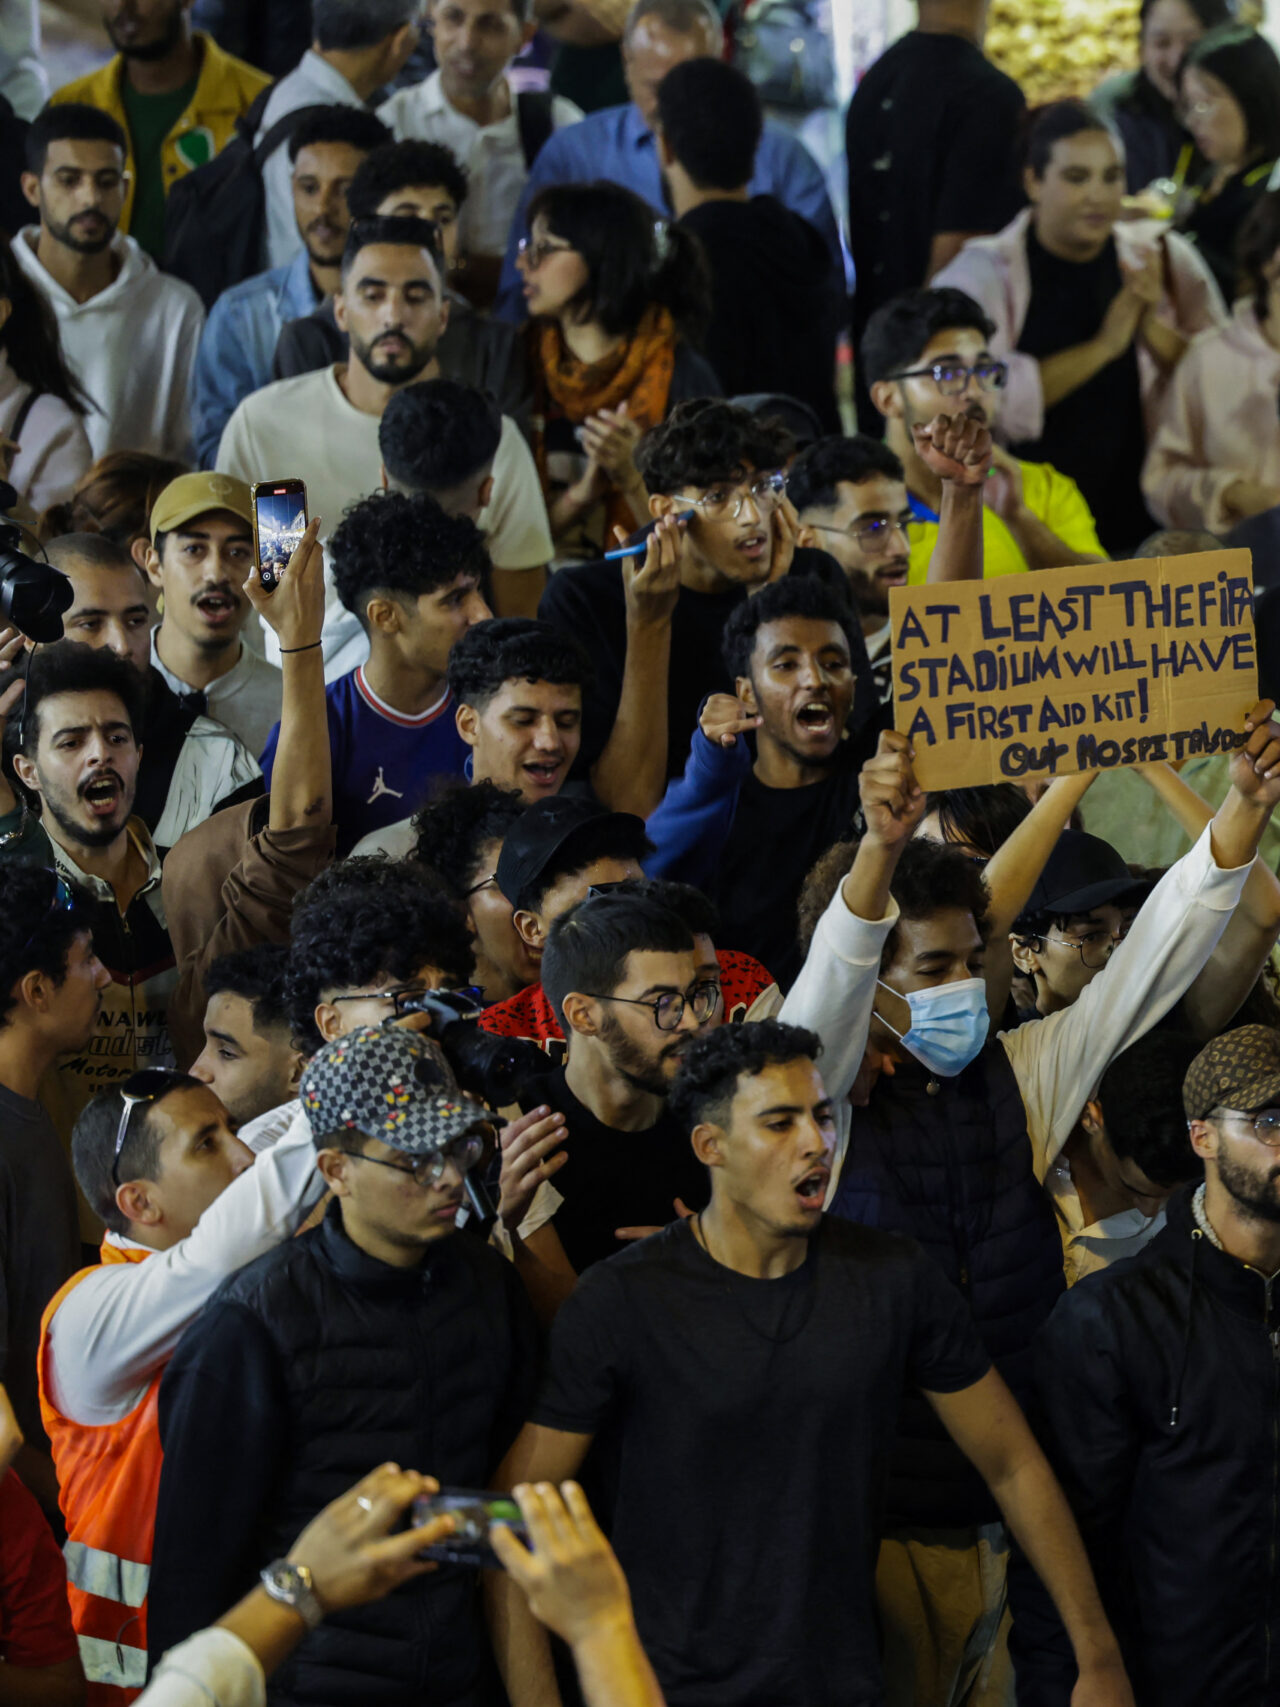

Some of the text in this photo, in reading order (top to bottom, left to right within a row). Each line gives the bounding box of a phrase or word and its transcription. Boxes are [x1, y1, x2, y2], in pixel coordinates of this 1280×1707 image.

[897, 605, 960, 649] AT
[979, 585, 1104, 641] LEAST
[1063, 639, 1147, 677] WILL
[1151, 633, 1254, 679] HAVE
[907, 706, 936, 746] A
[945, 702, 1033, 740] FIRST
[1039, 695, 1086, 732] AID
